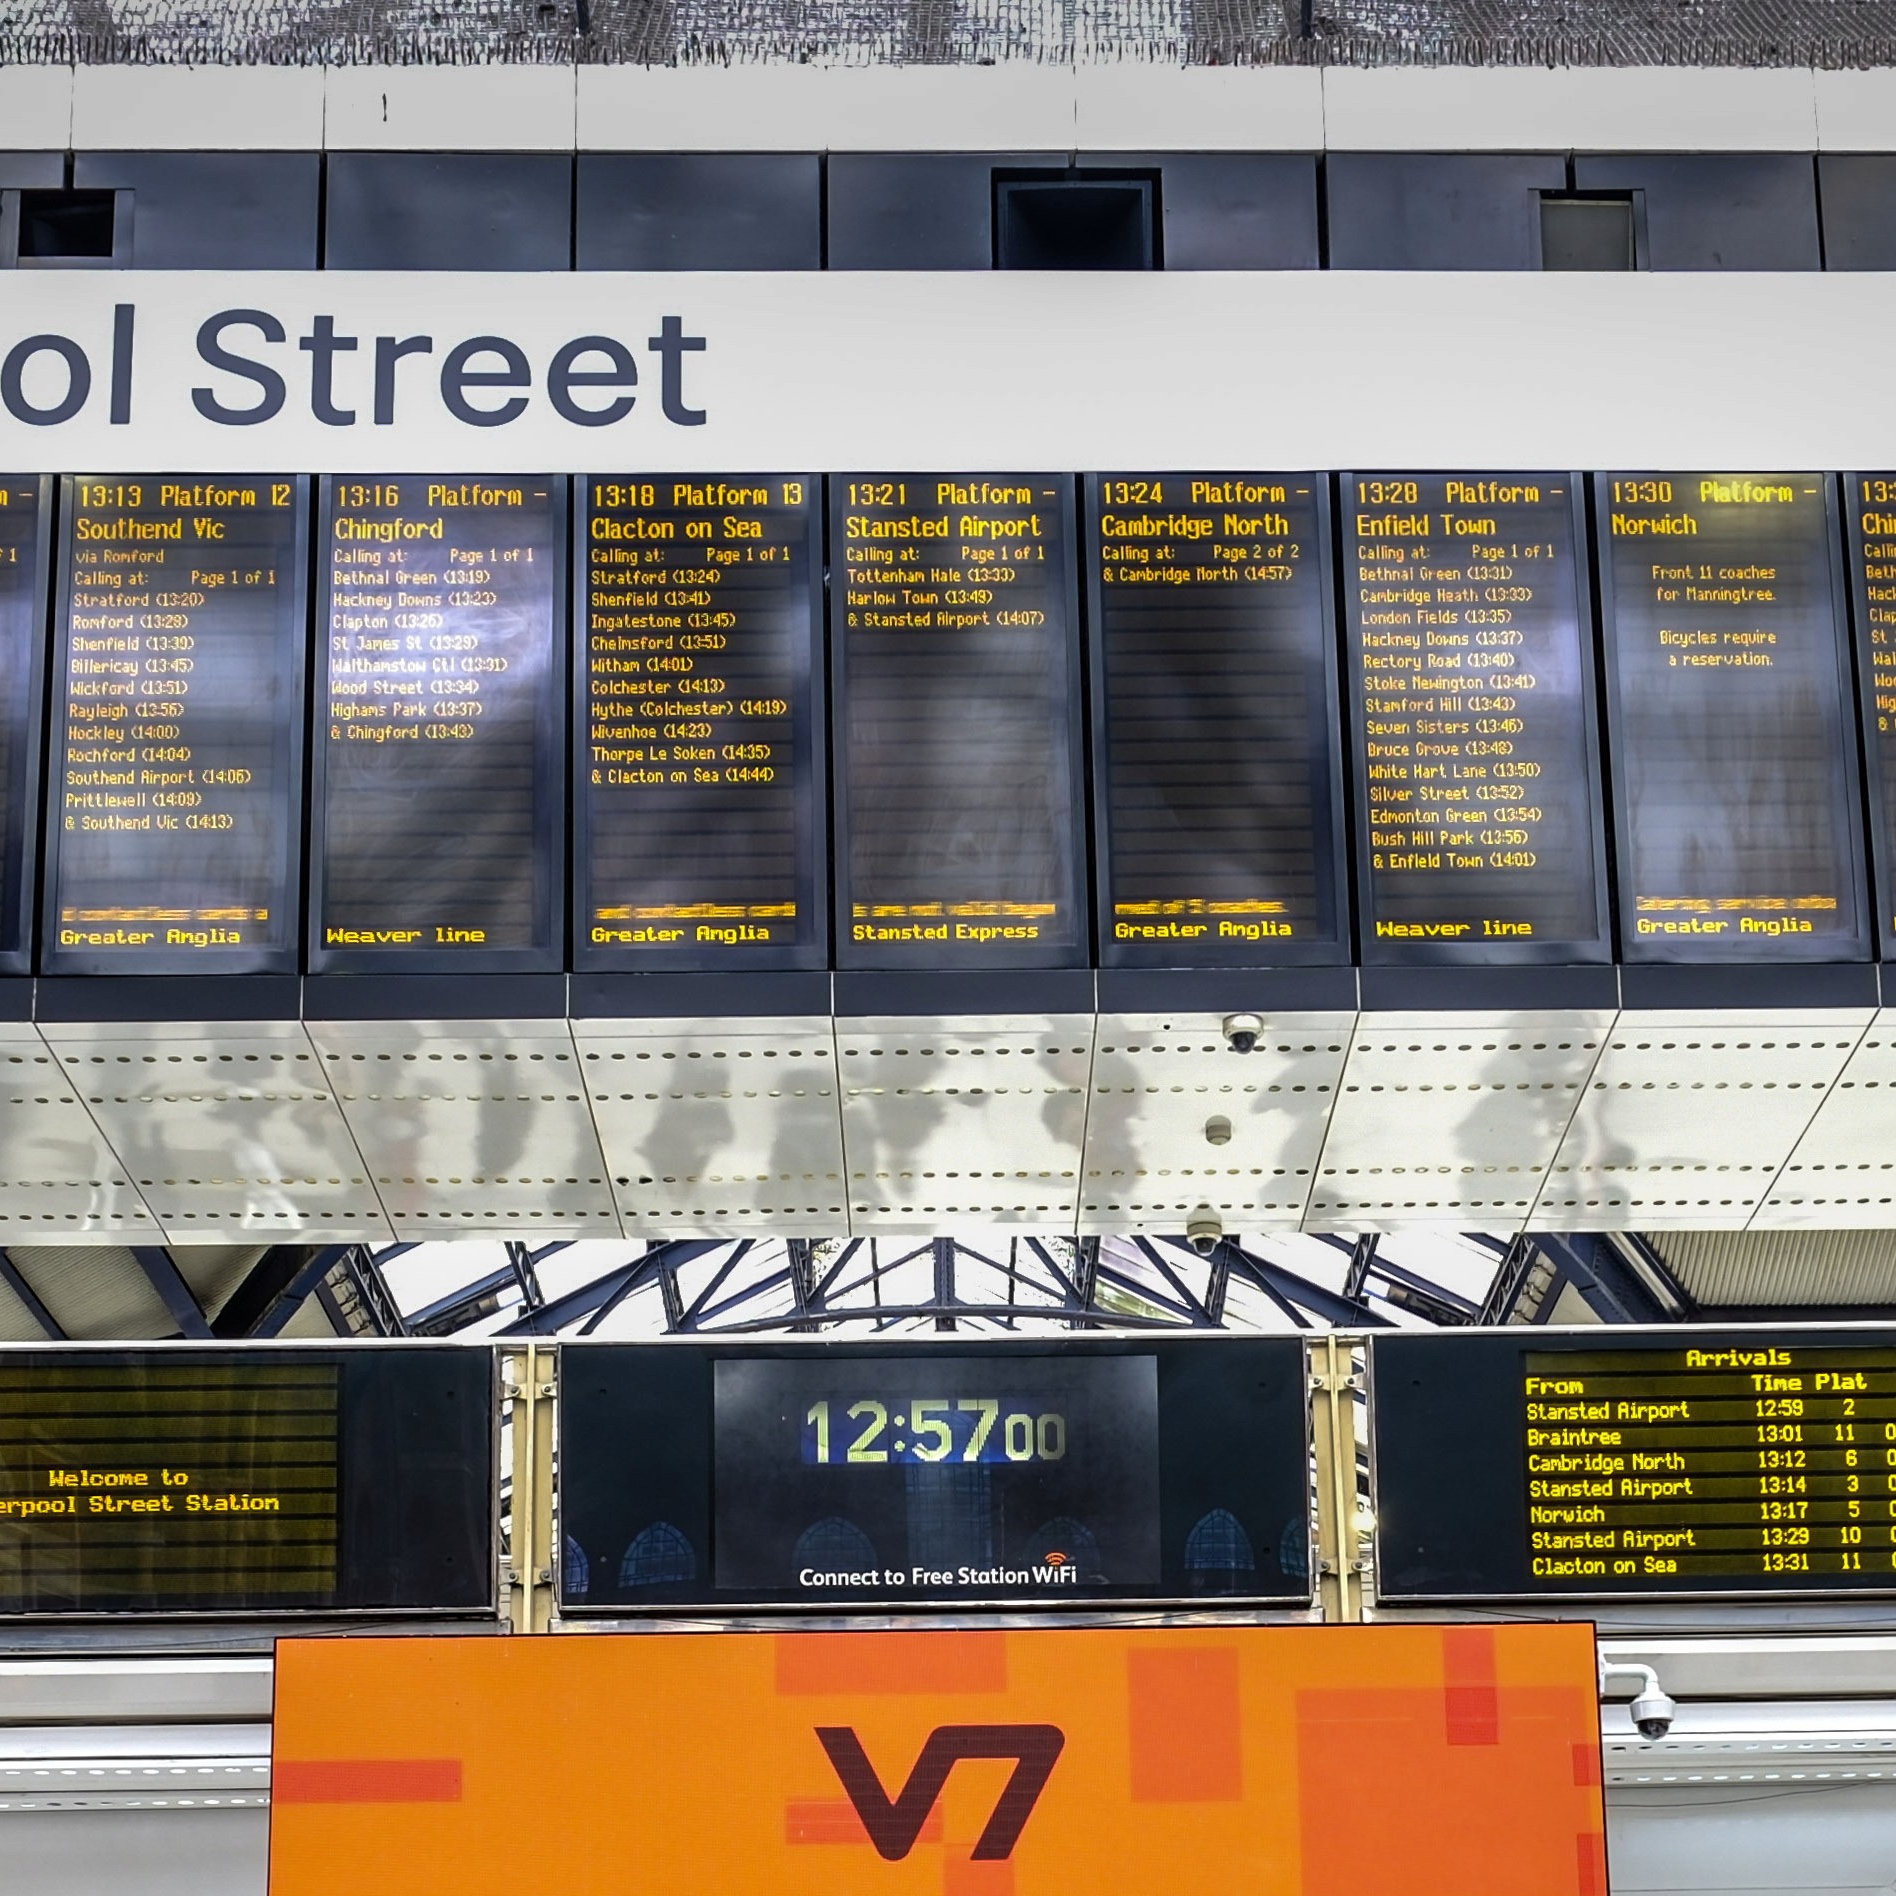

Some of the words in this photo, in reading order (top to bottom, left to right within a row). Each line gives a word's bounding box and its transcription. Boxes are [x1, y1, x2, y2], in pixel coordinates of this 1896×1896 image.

[190, 306, 707, 429] Street
[81, 484, 143, 508] 13:13
[160, 484, 257, 507] Platform
[271, 483, 291, 507] 12
[595, 484, 655, 508] 13:18
[673, 483, 769, 507] Platform
[782, 482, 804, 506] 13
[76, 517, 183, 541] Southend
[193, 517, 224, 539] Vic
[591, 517, 675, 540] Clacton
[685, 521, 713, 539] on
[723, 515, 763, 539] Sea
[1101, 514, 1214, 540] Cambridge
[1223, 513, 1289, 536] North
[1660, 629, 1719, 648] Bicycles
[1723, 632, 1777, 646] require
[1669, 655, 1680, 667] a
[1683, 652, 1771, 667] reservation.
[593, 745, 645, 764] Thorpe
[648, 748, 668, 762] Le
[673, 745, 716, 761] Soken
[1685, 1348, 1792, 1368] Arrivals
[1525, 1377, 1585, 1396] From
[1750, 1373, 1803, 1392] Time
[1814, 1372, 1868, 1391] Plat
[1526, 1401, 1610, 1421] Stansted
[1617, 1401, 1691, 1423] Airport
[1755, 1398, 1804, 1418] 12:59
[1842, 1398, 1856, 1416] 2
[806, 1399, 1002, 1463] 12:57
[1005, 1412, 1066, 1461] 00
[1527, 1427, 1622, 1447] Braintree
[1756, 1424, 1804, 1443] 13:01
[1834, 1423, 1855, 1442] 11
[1528, 1453, 1625, 1476] Cambridge
[1631, 1452, 1686, 1471] North
[1758, 1449, 1807, 1469] 13:12
[1845, 1449, 1858, 1467] 6
[48, 1469, 149, 1488] Welcome
[161, 1468, 190, 1486] to
[1529, 1478, 1614, 1498] Stansted
[1620, 1477, 1694, 1500] Airport
[1759, 1475, 1807, 1495] 13:14
[1846, 1474, 1860, 1493] 3
[88, 1494, 174, 1513] Street
[185, 1493, 280, 1512] Station
[1530, 1504, 1606, 1524] Norwich
[1759, 1501, 1809, 1521] 13:17
[1847, 1500, 1861, 1518] 5
[1531, 1530, 1616, 1550] Stansted
[1622, 1529, 1697, 1551] Airport
[1761, 1526, 1810, 1546] 13:29
[1840, 1526, 1862, 1545] 10
[800, 1568, 880, 1586] Connect
[886, 1569, 904, 1586] to
[913, 1568, 952, 1585] Free
[958, 1567, 1030, 1585] Station
[1032, 1566, 1076, 1585] WiFi
[1532, 1556, 1606, 1576] Clacton
[1613, 1560, 1637, 1575] on
[1643, 1555, 1678, 1574] Sea
[1762, 1552, 1810, 1572] 13:31
[1841, 1551, 1862, 1570] 11
[814, 1723, 1066, 1861] V7
